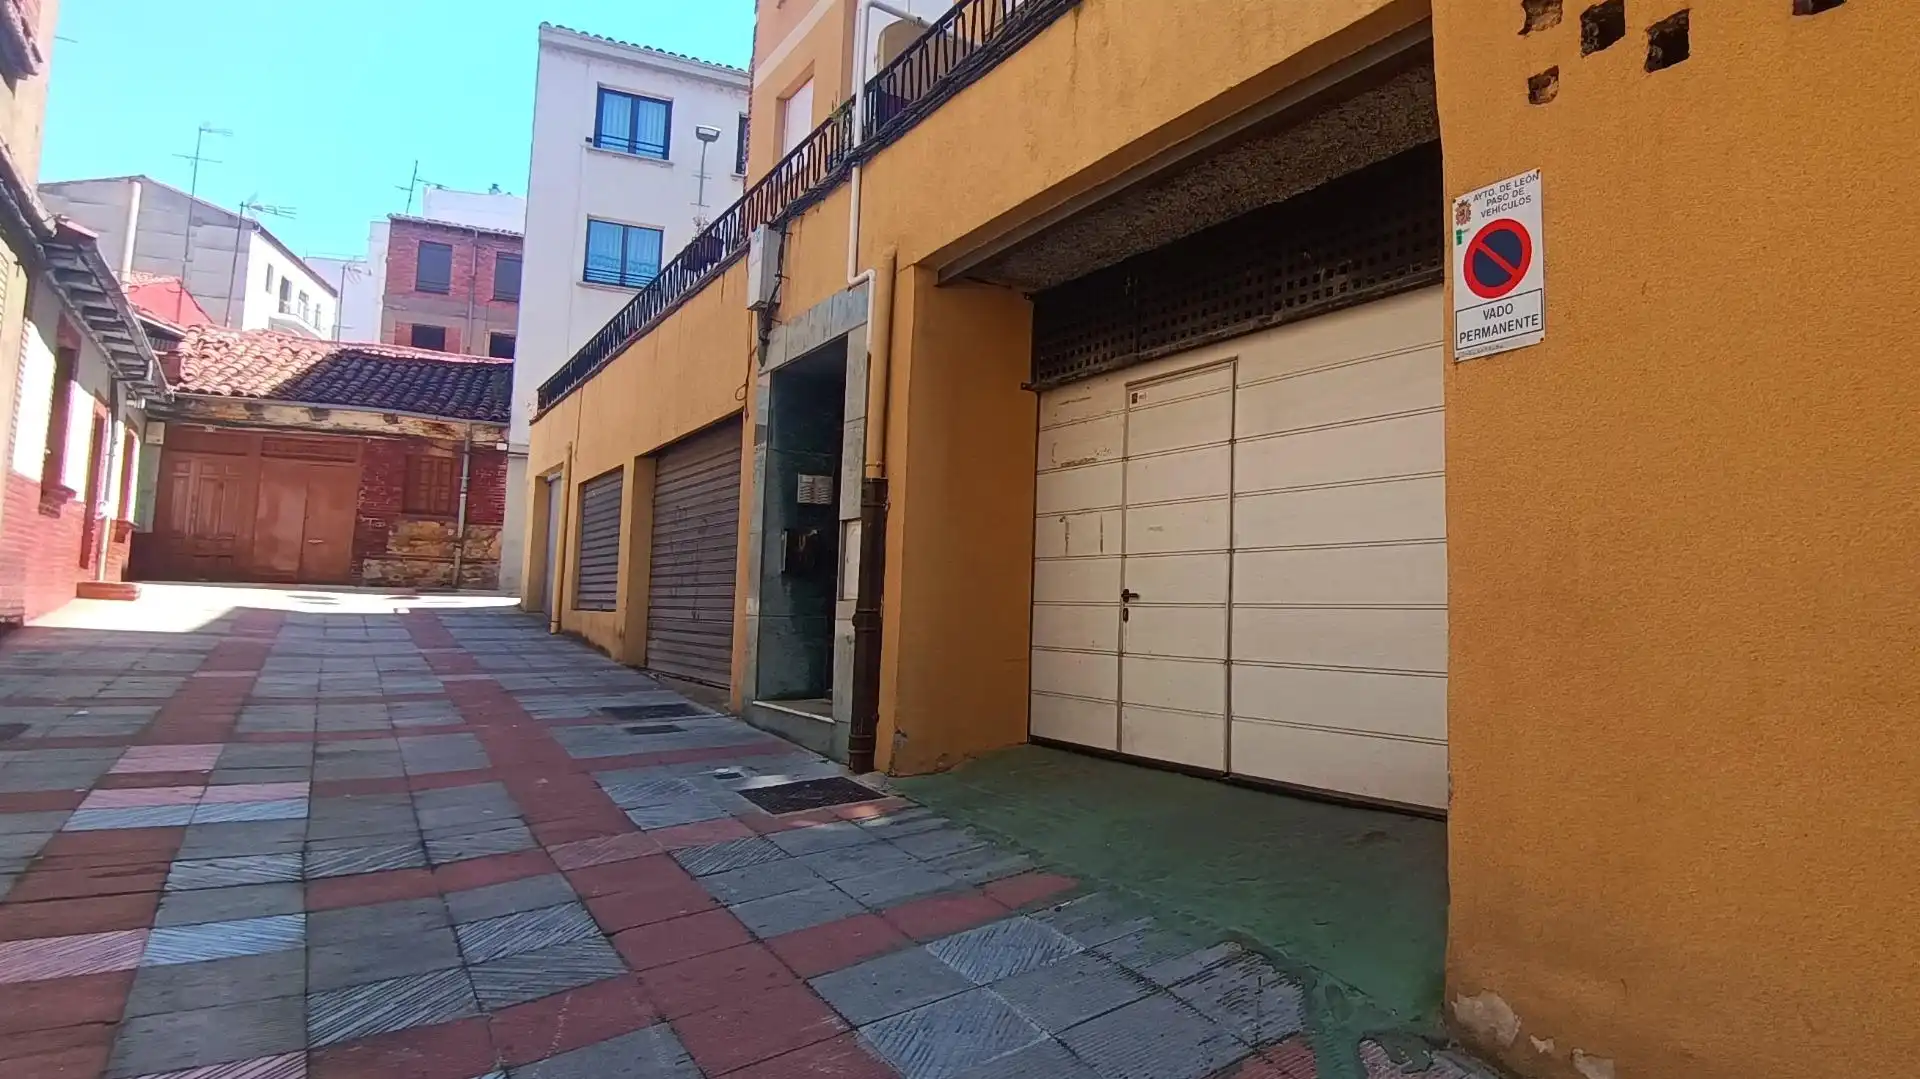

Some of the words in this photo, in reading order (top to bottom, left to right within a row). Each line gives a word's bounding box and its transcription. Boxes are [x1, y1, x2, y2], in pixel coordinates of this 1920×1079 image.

[1473, 188, 1497, 202] AYTO.
[1499, 182, 1512, 193] DE
[1514, 173, 1539, 188] LEÓN
[1486, 193, 1509, 207] PASO
[1512, 187, 1525, 198] DE
[1483, 303, 1514, 320] VADO
[1459, 313, 1539, 344] PERMANENTE
